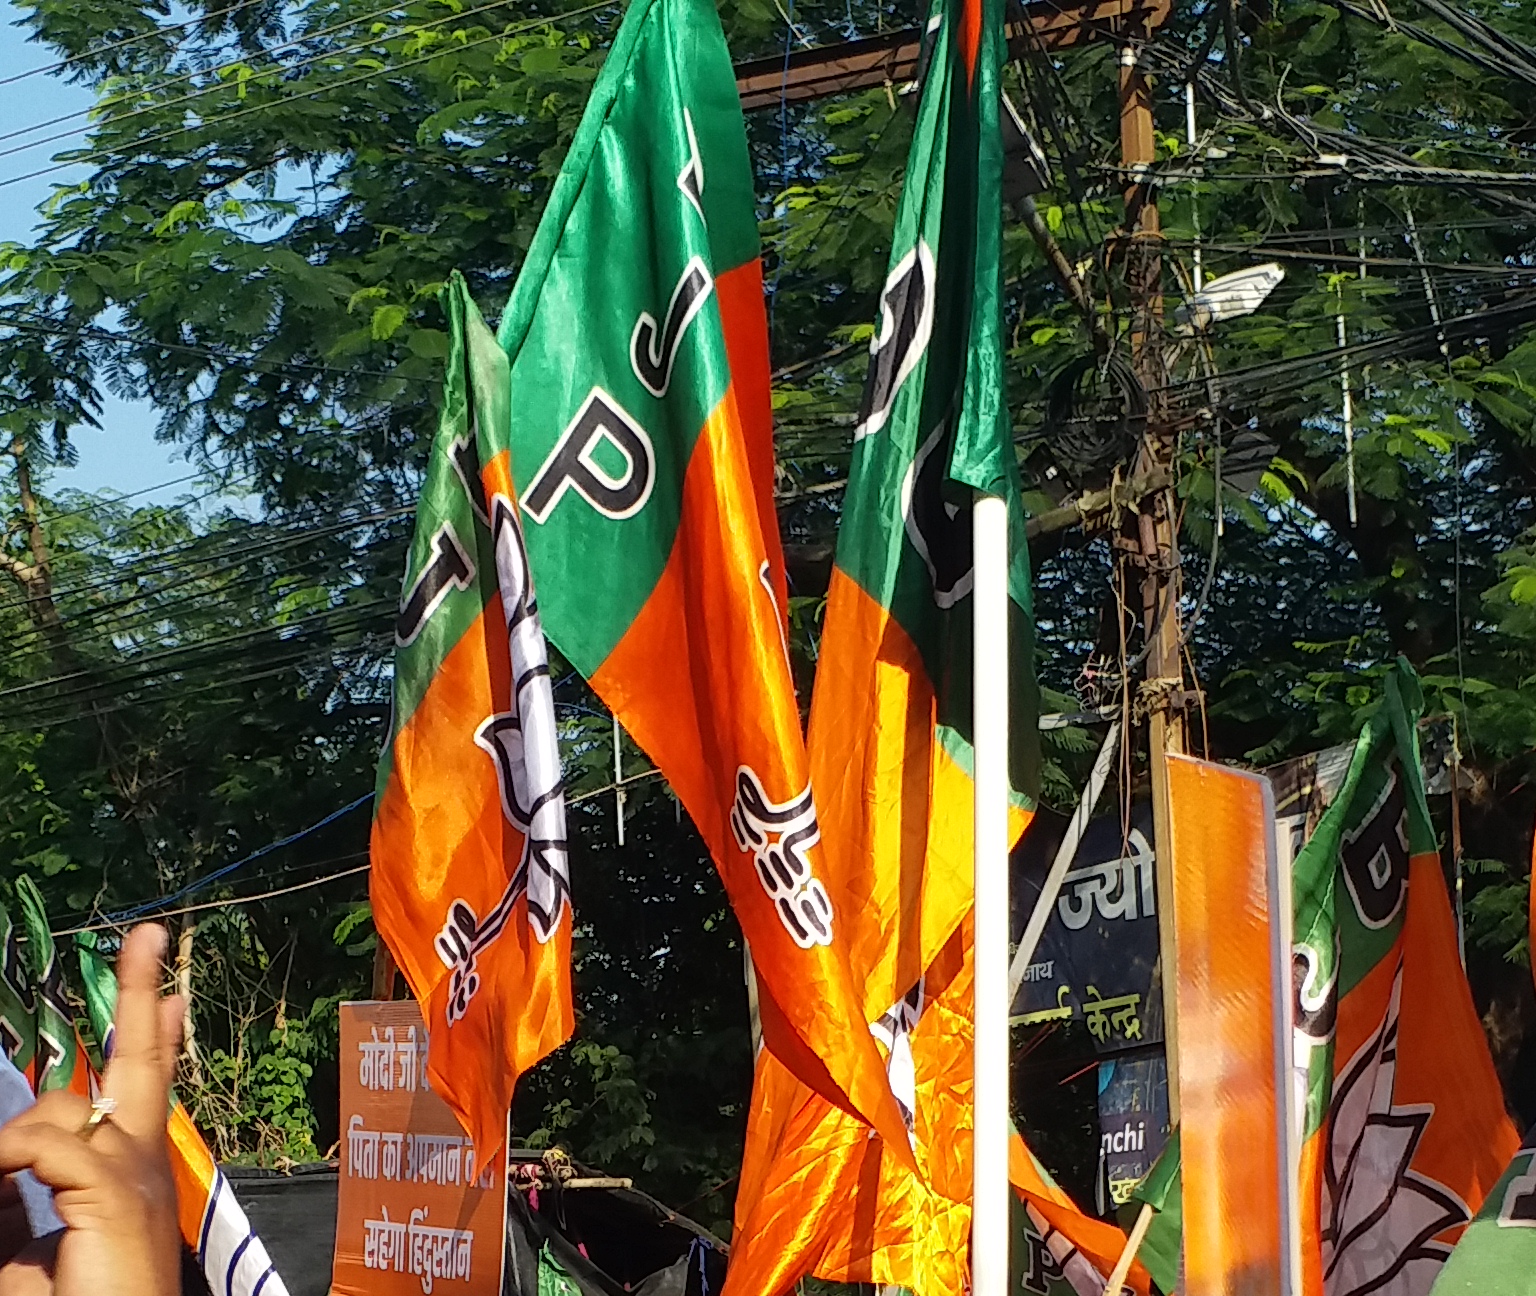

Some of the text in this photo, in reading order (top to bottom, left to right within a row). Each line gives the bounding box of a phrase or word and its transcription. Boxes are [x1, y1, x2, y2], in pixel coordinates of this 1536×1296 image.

[1058, 827, 1156, 930] ज्यो
[1082, 985, 1143, 1044] केन्द्र
[358, 1026, 396, 1091] मोदी
[397, 1025, 419, 1092] जी
[347, 1114, 381, 1181] पिता
[381, 1132, 405, 1182] का
[406, 1132, 464, 1187] अपमान
[1101, 1121, 1145, 1154] nchi
[364, 1204, 474, 1296] सहेगा हिंदुस्तान
